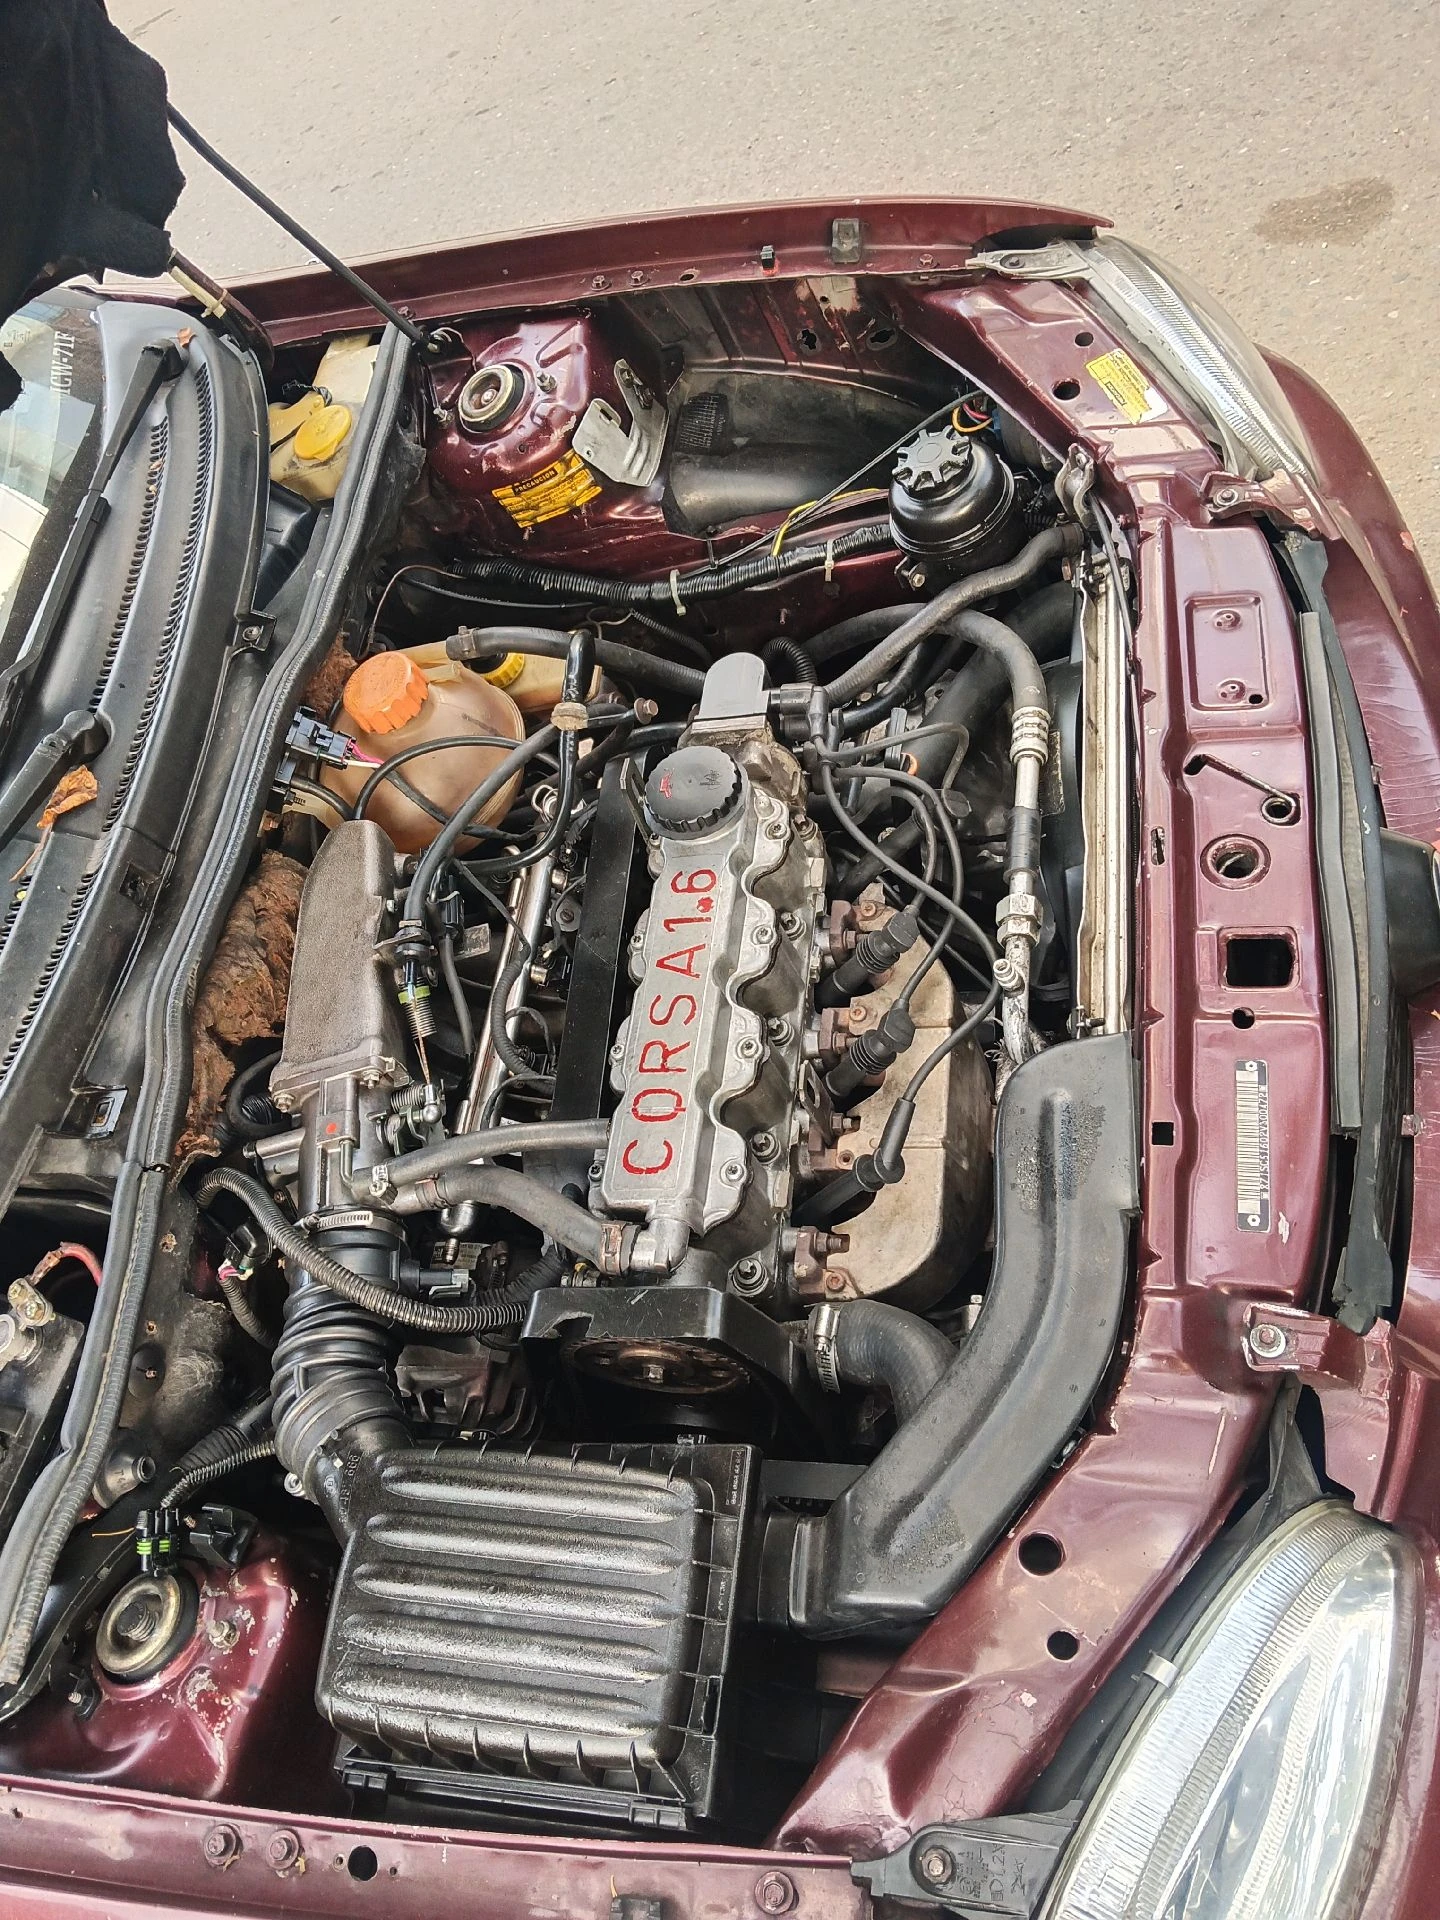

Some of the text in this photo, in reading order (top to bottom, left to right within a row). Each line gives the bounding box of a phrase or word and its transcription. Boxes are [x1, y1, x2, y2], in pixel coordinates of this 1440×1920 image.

[513, 468, 556, 494] PRECAUCION
[621, 868, 718, 1176] CORSA 1.6
